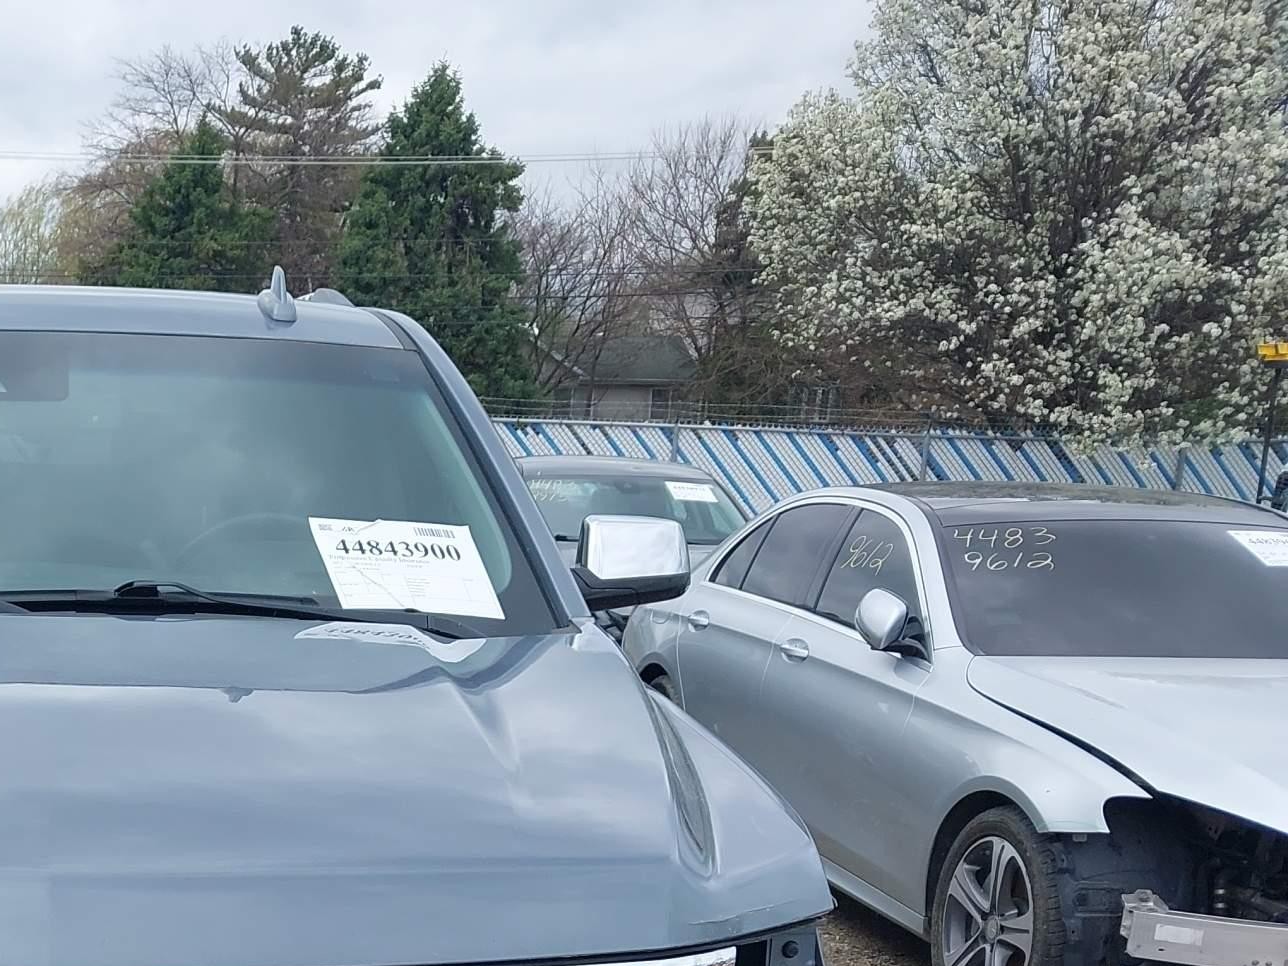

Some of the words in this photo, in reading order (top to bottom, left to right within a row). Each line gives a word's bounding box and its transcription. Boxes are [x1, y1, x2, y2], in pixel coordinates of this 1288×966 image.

[954, 527, 1057, 549] 4483
[335, 538, 462, 562] 44843900
[964, 551, 1055, 572] 9612
